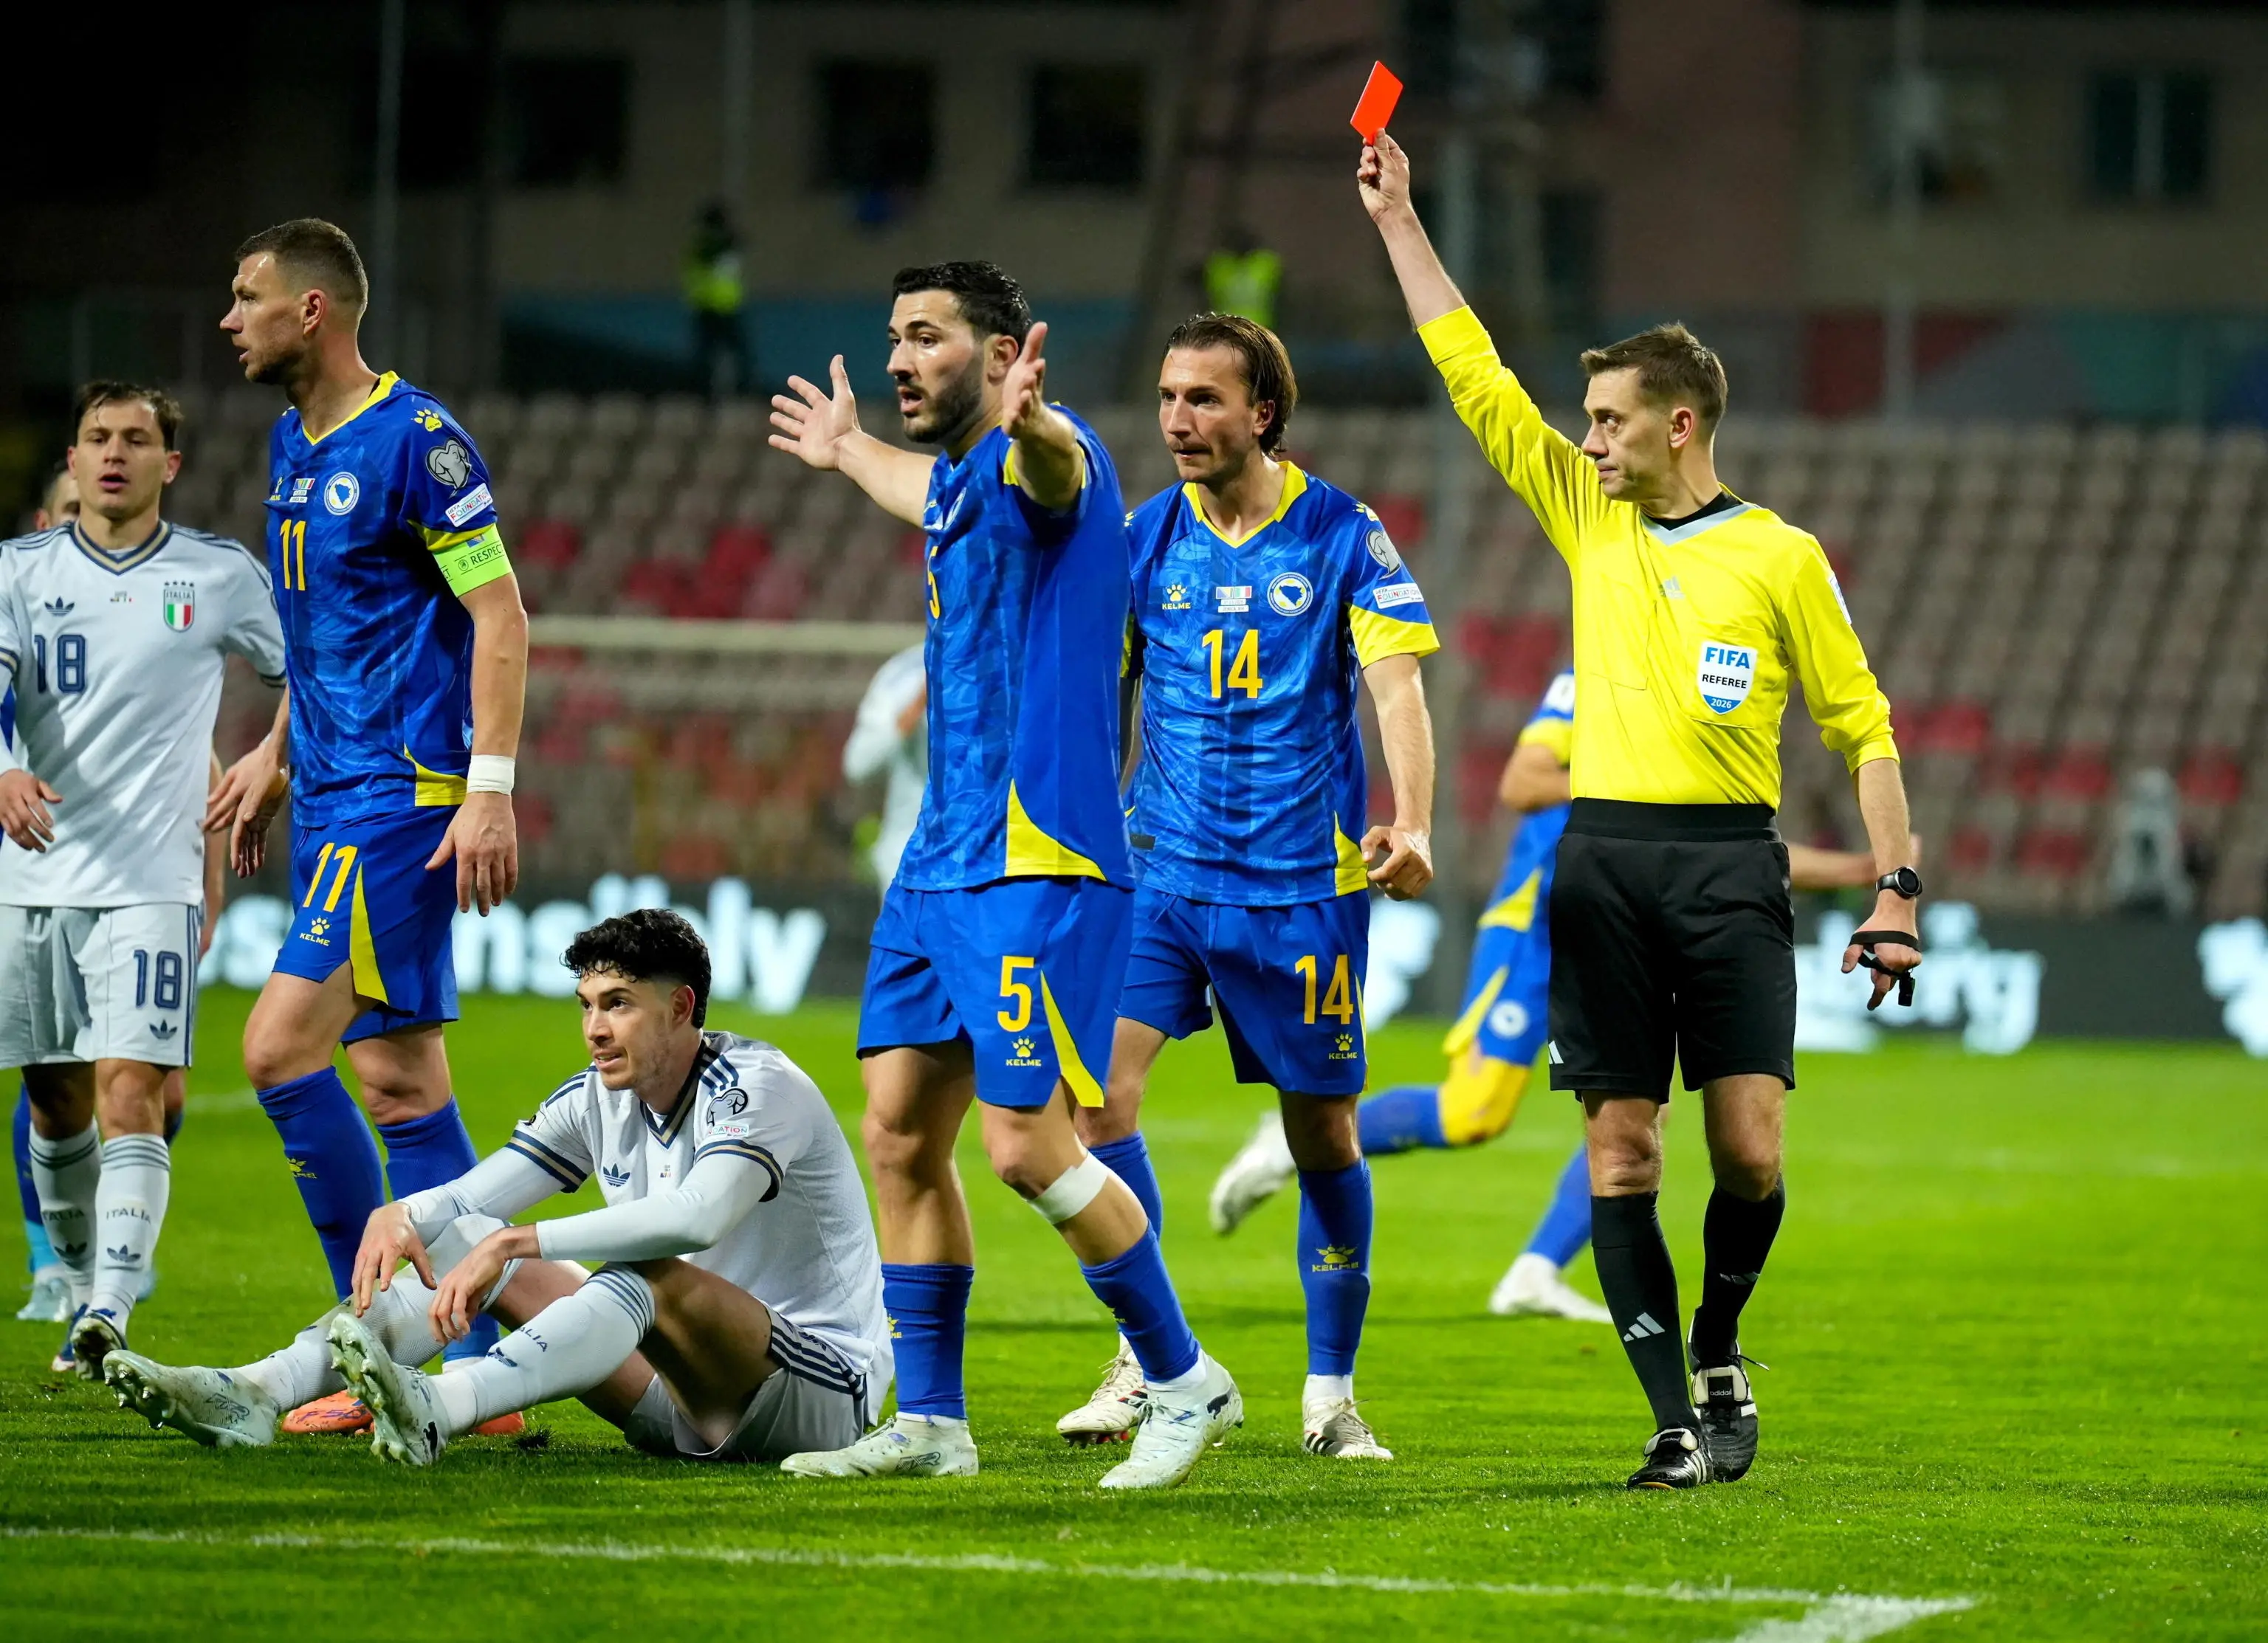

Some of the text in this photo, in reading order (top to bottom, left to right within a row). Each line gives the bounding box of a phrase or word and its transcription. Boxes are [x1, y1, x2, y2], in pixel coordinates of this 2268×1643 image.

[281, 519, 306, 591] 11
[166, 590, 191, 599] ITALIA
[34, 634, 86, 694] 18
[1203, 629, 1263, 699] 14
[1705, 647, 1750, 669] FIFA
[1702, 674, 1748, 689] REFEREE
[1711, 698, 1732, 709] 2026
[303, 842, 358, 912] 11
[299, 932, 331, 946] KELME
[134, 949, 182, 1009] 18
[1295, 954, 1354, 1024] 14
[997, 956, 1034, 1032] 5
[106, 1208, 151, 1224] ITALIA
[1312, 1262, 1358, 1272] KELME
[1710, 1388, 1732, 1396] adidas
